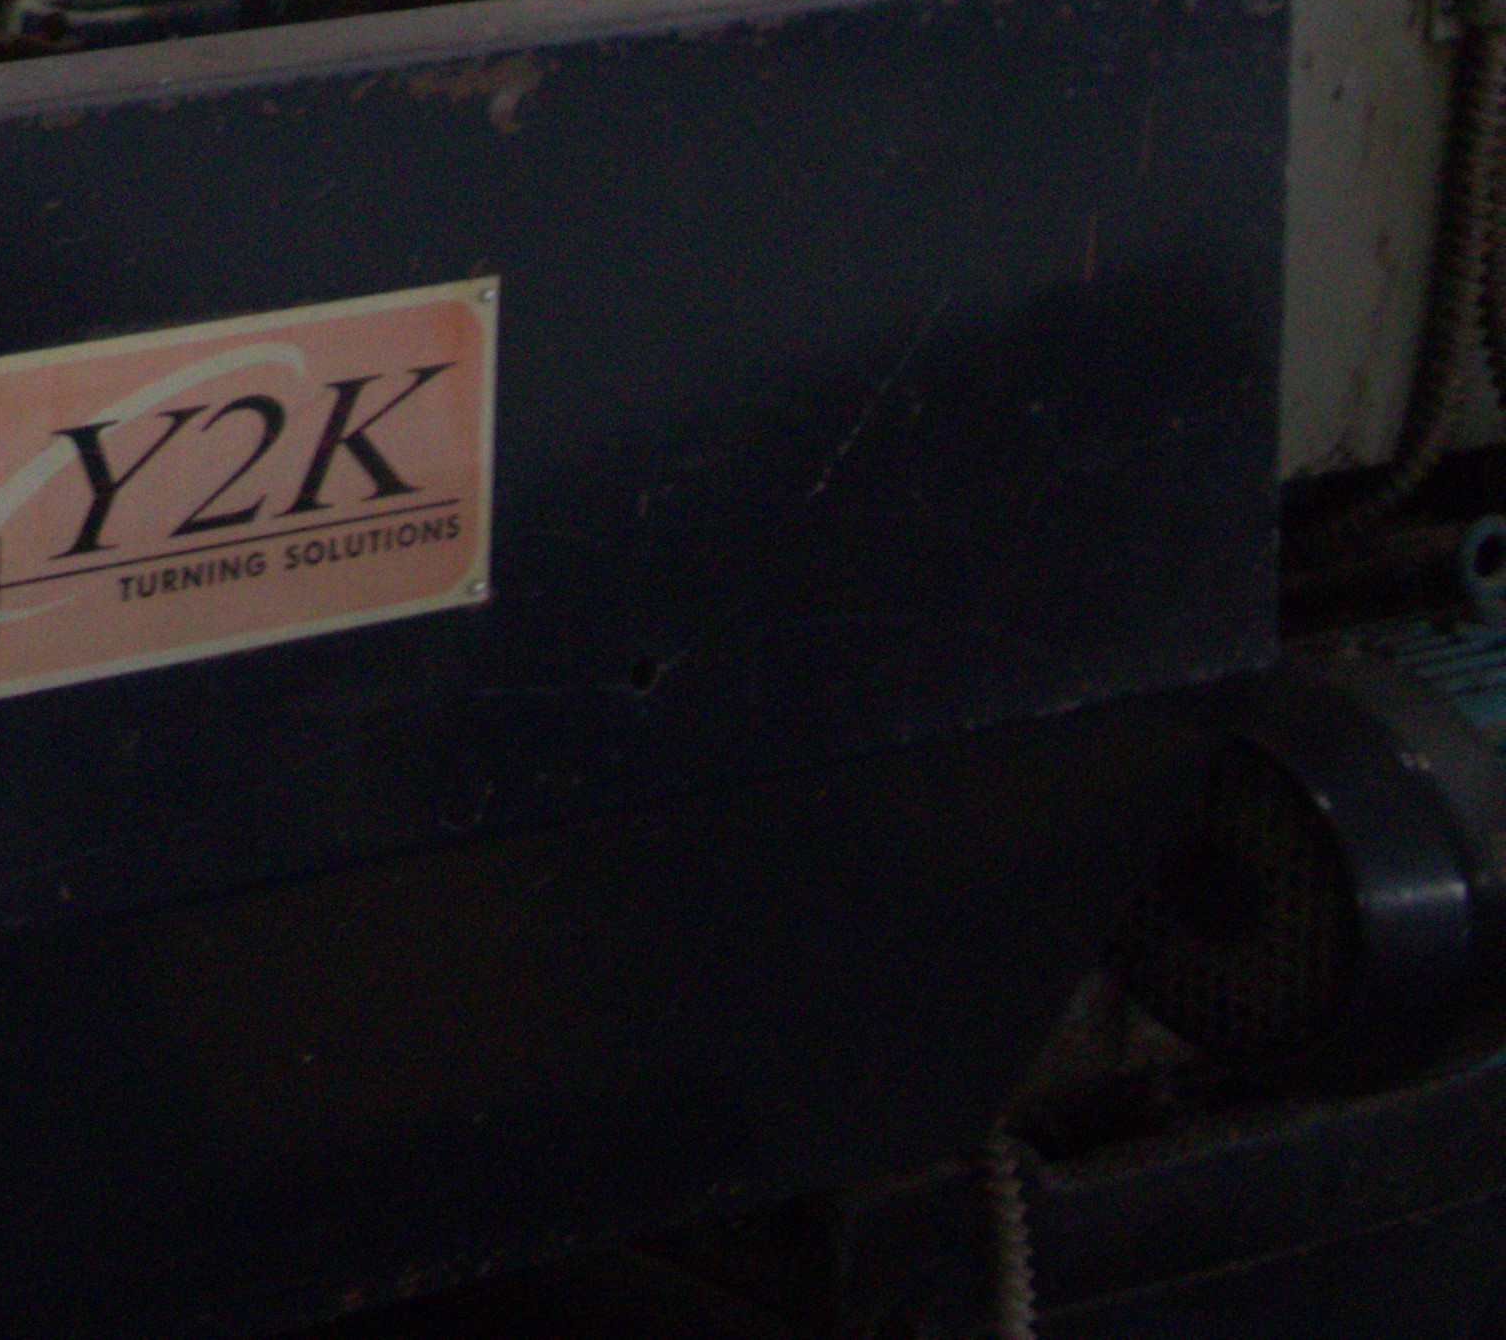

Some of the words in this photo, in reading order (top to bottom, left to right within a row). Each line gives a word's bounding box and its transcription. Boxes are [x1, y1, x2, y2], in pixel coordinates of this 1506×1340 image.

[49, 360, 458, 561] Y2K
[118, 551, 268, 602] TURNING
[284, 513, 463, 571] SOLUTIONS
